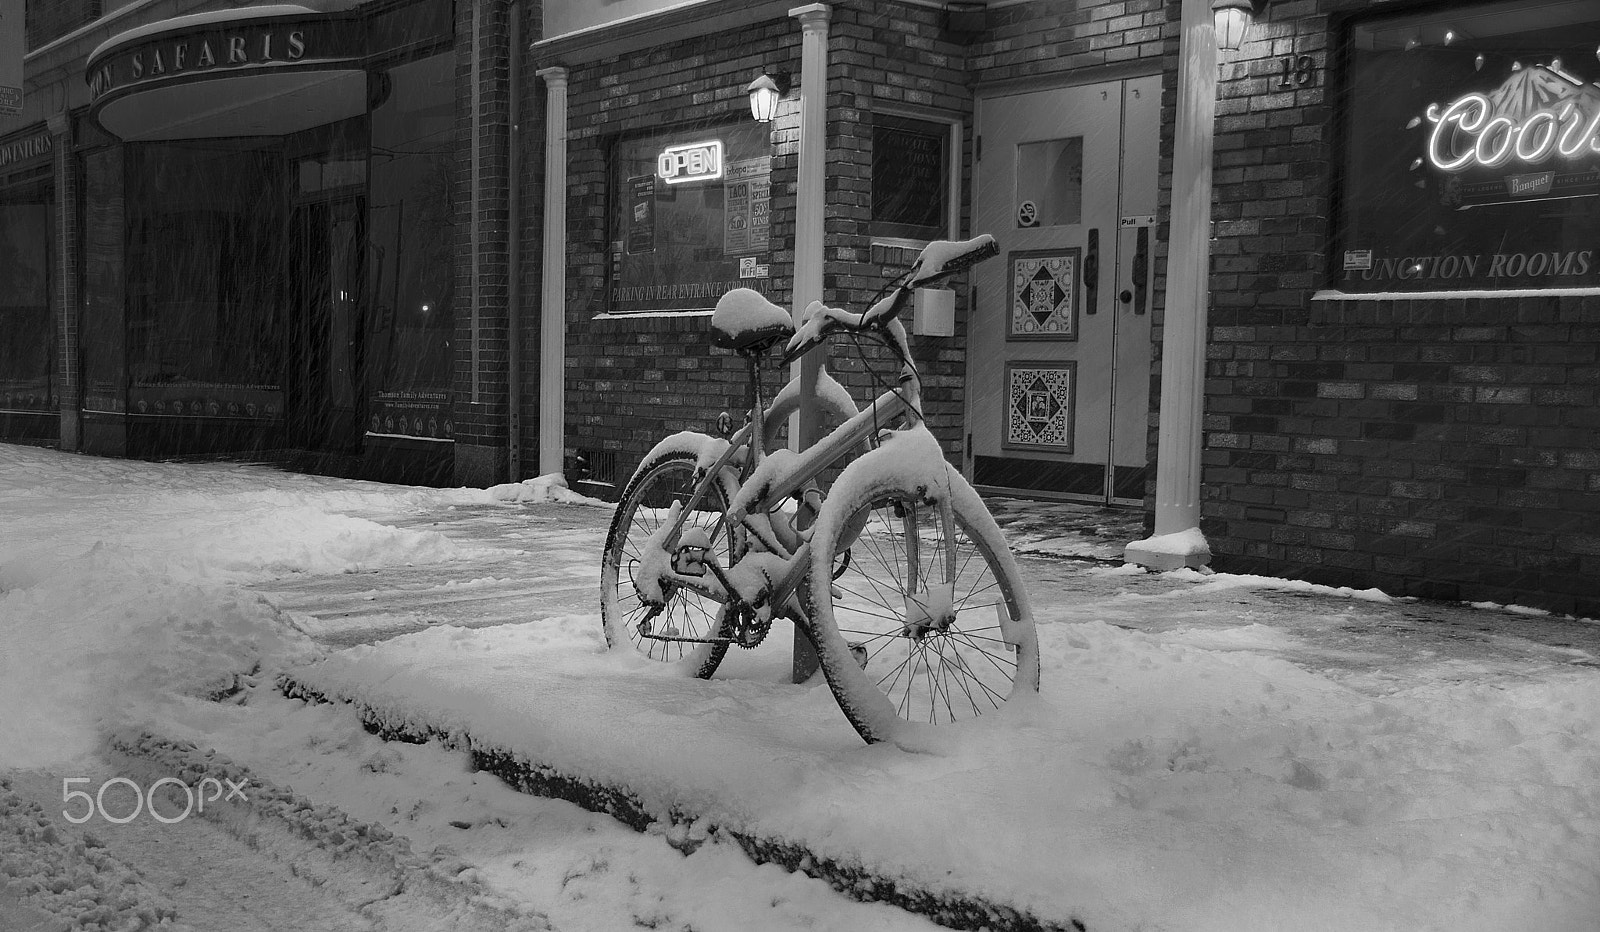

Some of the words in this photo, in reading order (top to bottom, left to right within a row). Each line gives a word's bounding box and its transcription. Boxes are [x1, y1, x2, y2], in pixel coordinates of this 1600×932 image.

[132, 31, 305, 79] SAFARIS
[1277, 55, 1314, 87] 18
[0, 134, 52, 167] DVENTURES
[658, 146, 717, 178] OPEN
[727, 184, 747, 199] TACO
[1511, 174, 1549, 194] Banquet
[1486, 250, 1593, 279] ROOMS
[611, 286, 645, 302] PARKING
[645, 285, 656, 301] IN
[656, 284, 678, 300] REAR
[678, 281, 722, 299] ENTRANCE
[377, 390, 400, 399] Thomson
[400, 390, 417, 400] Family
[417, 391, 446, 400] Adventures
